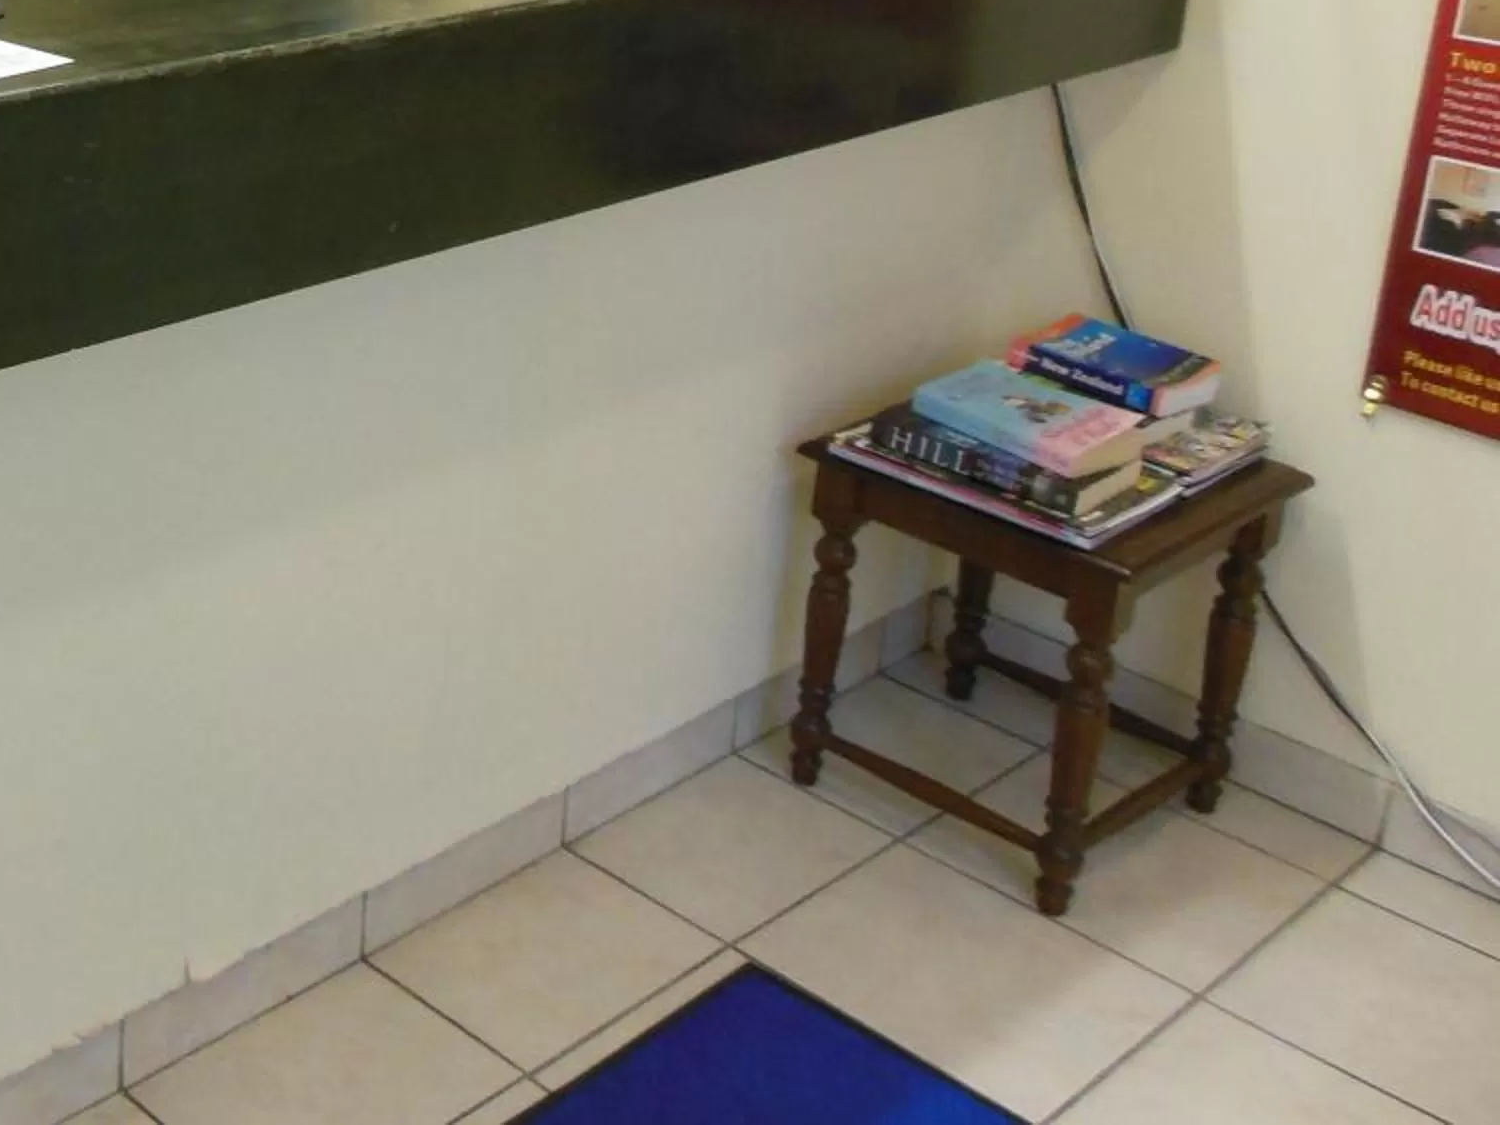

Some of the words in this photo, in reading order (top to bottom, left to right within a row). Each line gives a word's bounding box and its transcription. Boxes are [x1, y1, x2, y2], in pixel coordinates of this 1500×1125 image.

[1449, 51, 1497, 75] Two
[1411, 284, 1474, 339] Add
[1040, 357, 1069, 376] New
[1071, 368, 1125, 396] Zealand
[1403, 350, 1453, 376] Please
[1401, 371, 1420, 389] To
[1421, 381, 1479, 407] contact
